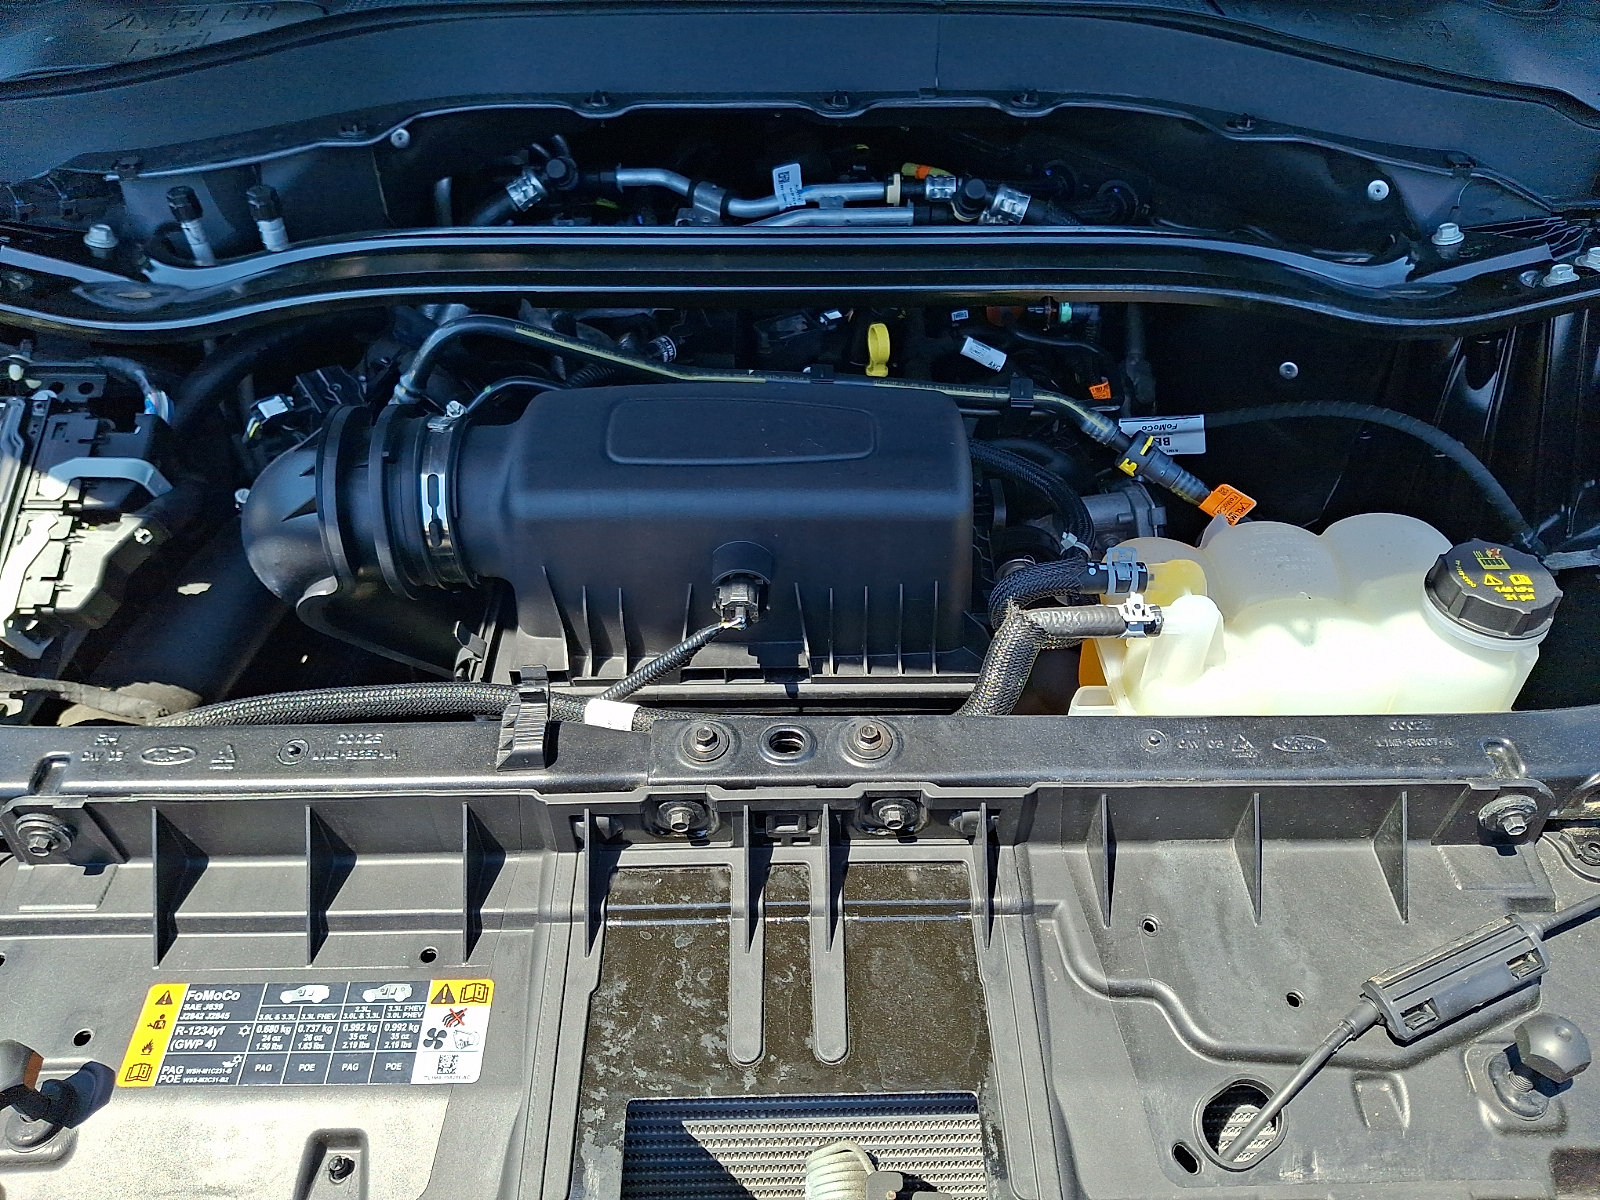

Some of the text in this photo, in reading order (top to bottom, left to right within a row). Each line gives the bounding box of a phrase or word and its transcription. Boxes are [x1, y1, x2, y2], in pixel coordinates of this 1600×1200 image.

[1141, 423, 1178, 431] FoMoCo
[186, 990, 241, 1002] FoMoCo
[182, 1003, 203, 1011] SAE
[175, 1025, 226, 1037] R-1234yf
[256, 1024, 292, 1035] 0.680 kg
[298, 1024, 333, 1035] 0.737 kg
[342, 1023, 378, 1034] 0.992 kg
[384, 1023, 420, 1033] 0.992 kg
[170, 1039, 217, 1051] (GWP 4)
[313, 1042, 325, 1050] lbs
[342, 1041, 370, 1049] 2.19 lbs
[384, 1041, 412, 1049] 2.19 lbs
[161, 1065, 184, 1074] PAG
[254, 1063, 273, 1072] PAG
[298, 1063, 316, 1072] POE
[341, 1063, 359, 1071] PAG
[385, 1062, 403, 1071] POE
[158, 1074, 182, 1083] POE
